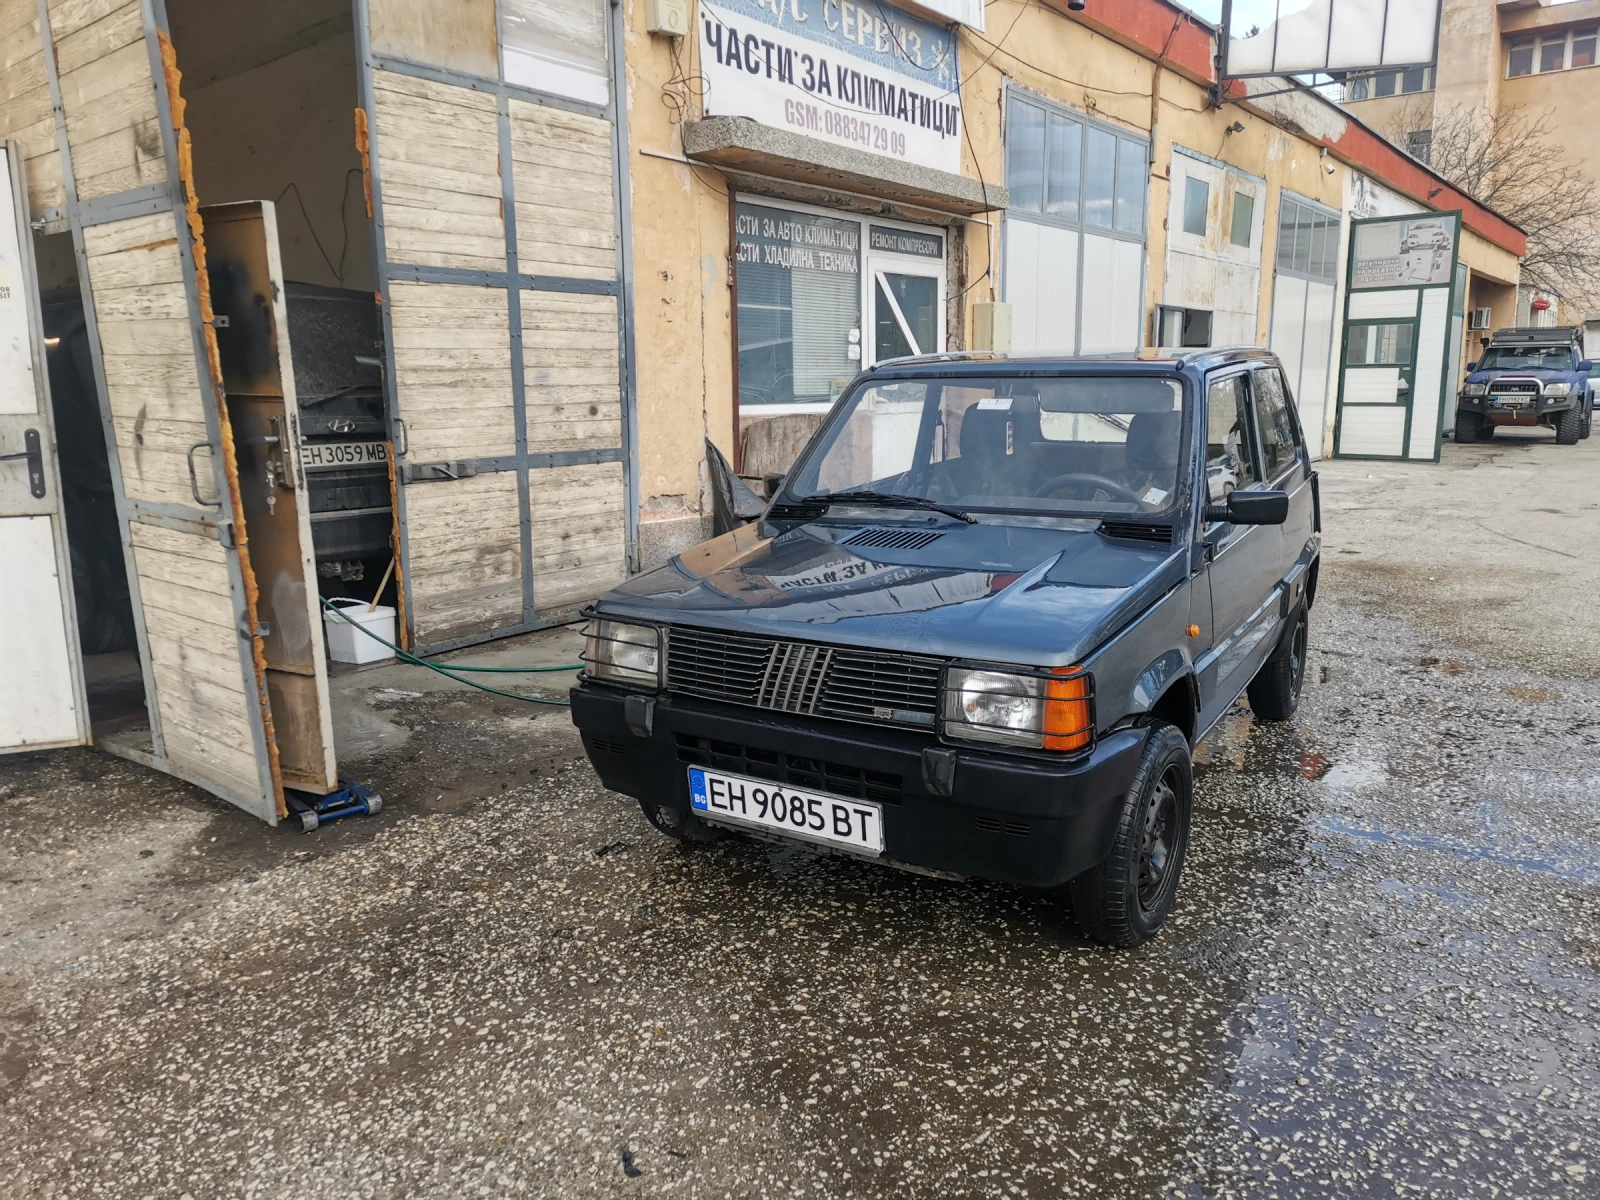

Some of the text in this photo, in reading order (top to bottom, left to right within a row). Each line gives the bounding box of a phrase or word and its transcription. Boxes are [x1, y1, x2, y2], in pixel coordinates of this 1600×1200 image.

[823, 0, 922, 68] СЕРВИЗ
[705, 20, 957, 139] ЧАСТИ ЗА КЛИМАТИЦИ
[785, 98, 823, 132] GSM:
[736, 214, 859, 252] СТИ ЗА АВТО КЛИМАТИЦИ
[871, 231, 897, 249] РЕМОНТ
[736, 241, 858, 273] СТИ ХЛАДИЛНА ТЕХНИКА
[325, 445, 363, 463] 3059
[365, 443, 387, 461] MB
[694, 793, 706, 805] BG
[708, 778, 873, 842] EH 9085 BT
